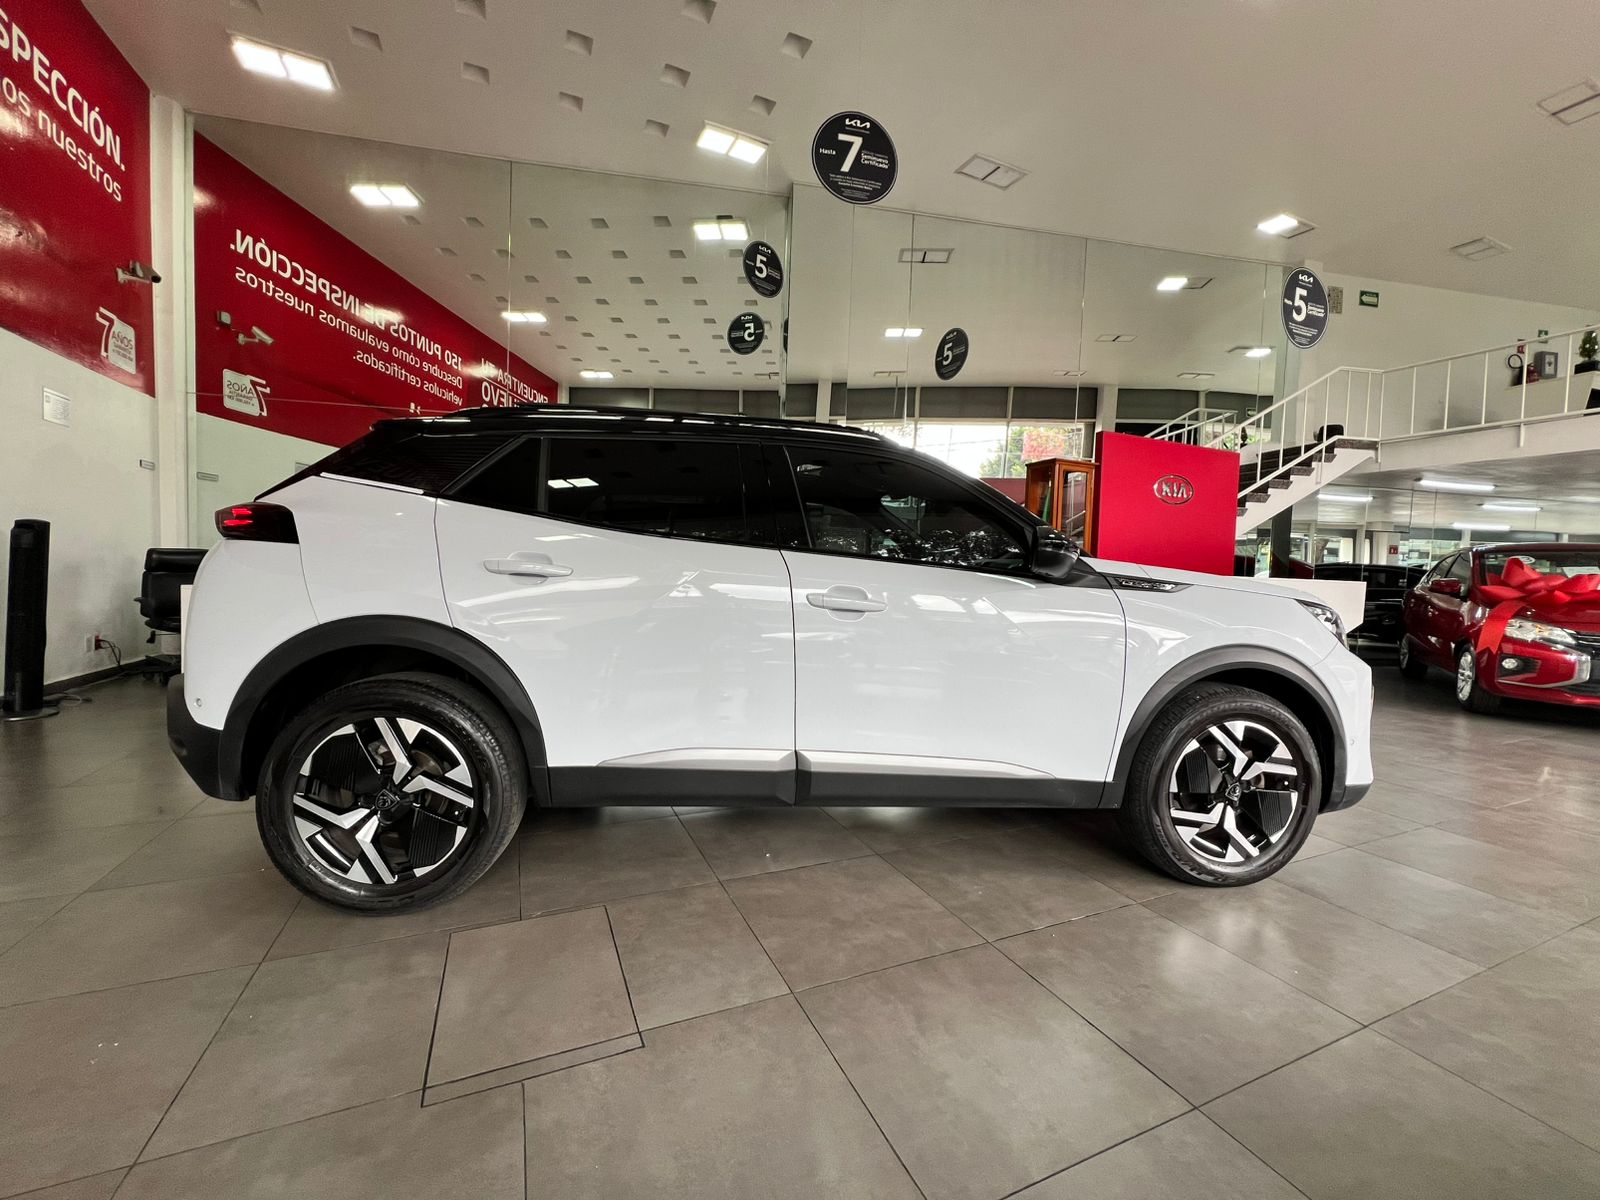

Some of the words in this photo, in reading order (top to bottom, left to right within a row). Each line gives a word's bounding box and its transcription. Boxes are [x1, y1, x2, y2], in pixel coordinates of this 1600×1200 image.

[38, 109, 122, 202] nuestros
[819, 147, 836, 156] Hasta
[837, 133, 863, 172] 7
[755, 254, 767, 279] 5
[1292, 286, 1307, 322] 5
[942, 342, 953, 365] 5
[1161, 481, 1188, 499] KIA
